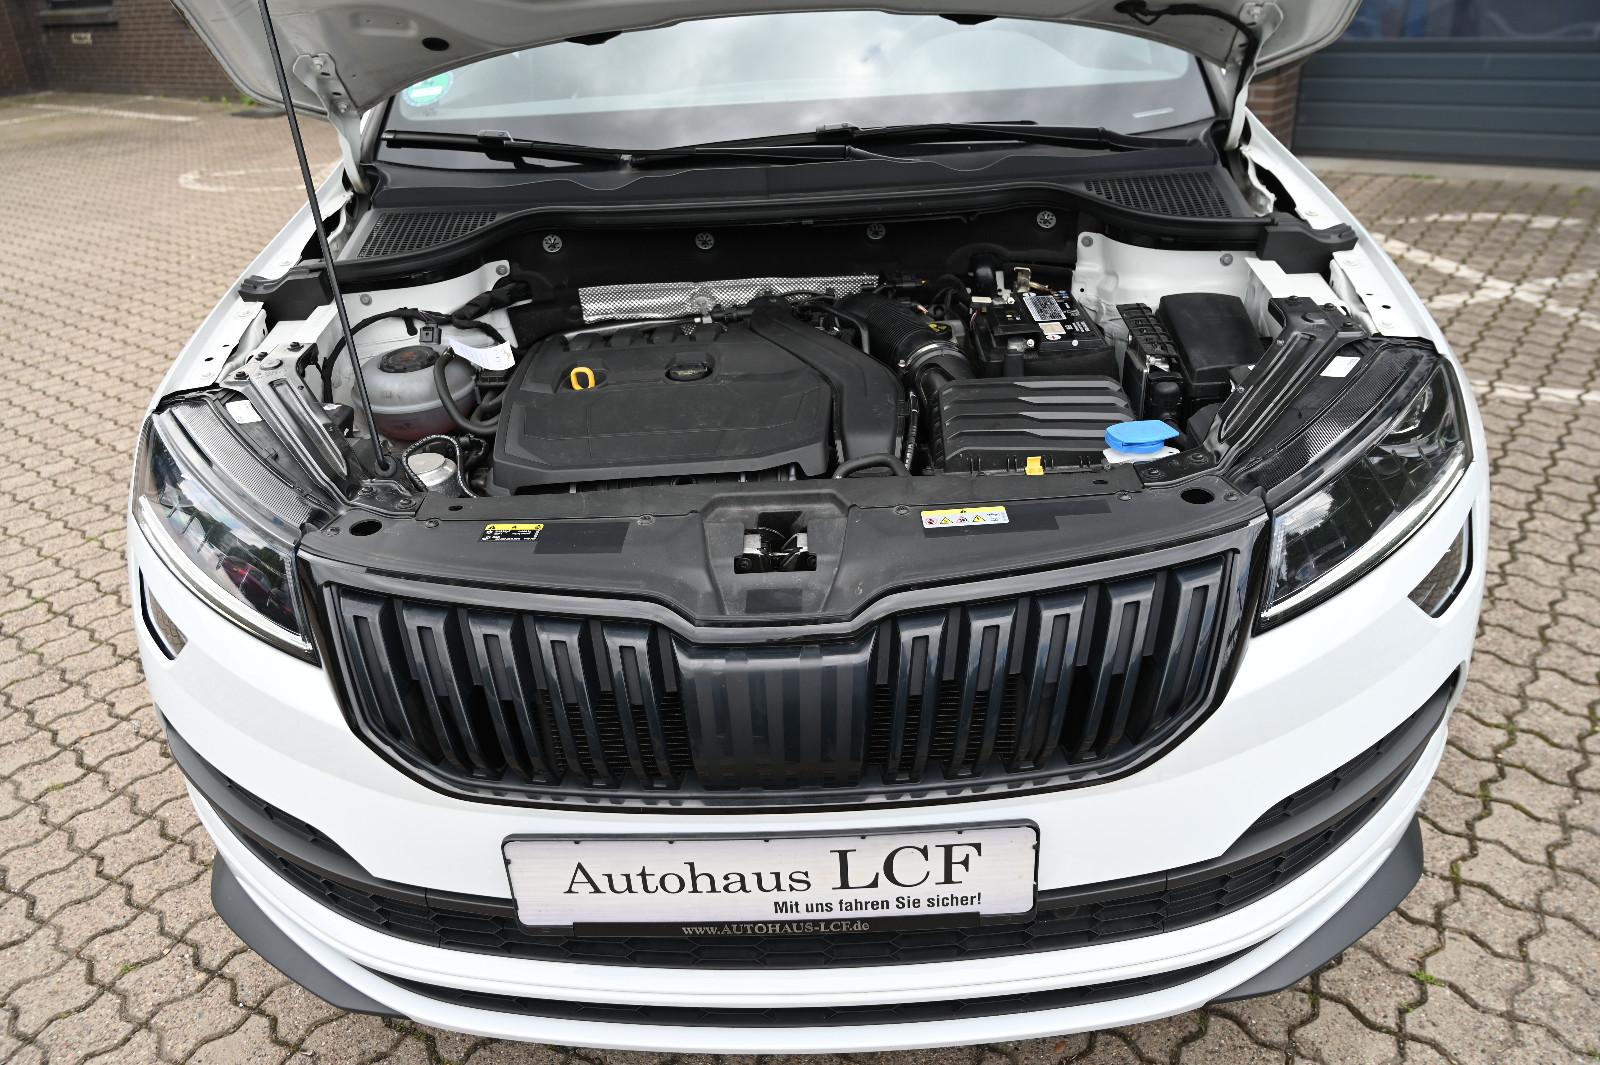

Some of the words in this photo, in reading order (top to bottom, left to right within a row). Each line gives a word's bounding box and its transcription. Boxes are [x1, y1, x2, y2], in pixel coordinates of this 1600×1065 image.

[563, 861, 812, 894] Autohaus
[829, 842, 982, 890] LCF
[773, 900, 800, 914] Mit
[805, 900, 833, 913] uns
[838, 898, 890, 912] fahren
[895, 896, 921, 910] Sie
[926, 892, 982, 908] sicher!
[681, 920, 870, 935] www.AUTOHAUS-LCF.de
